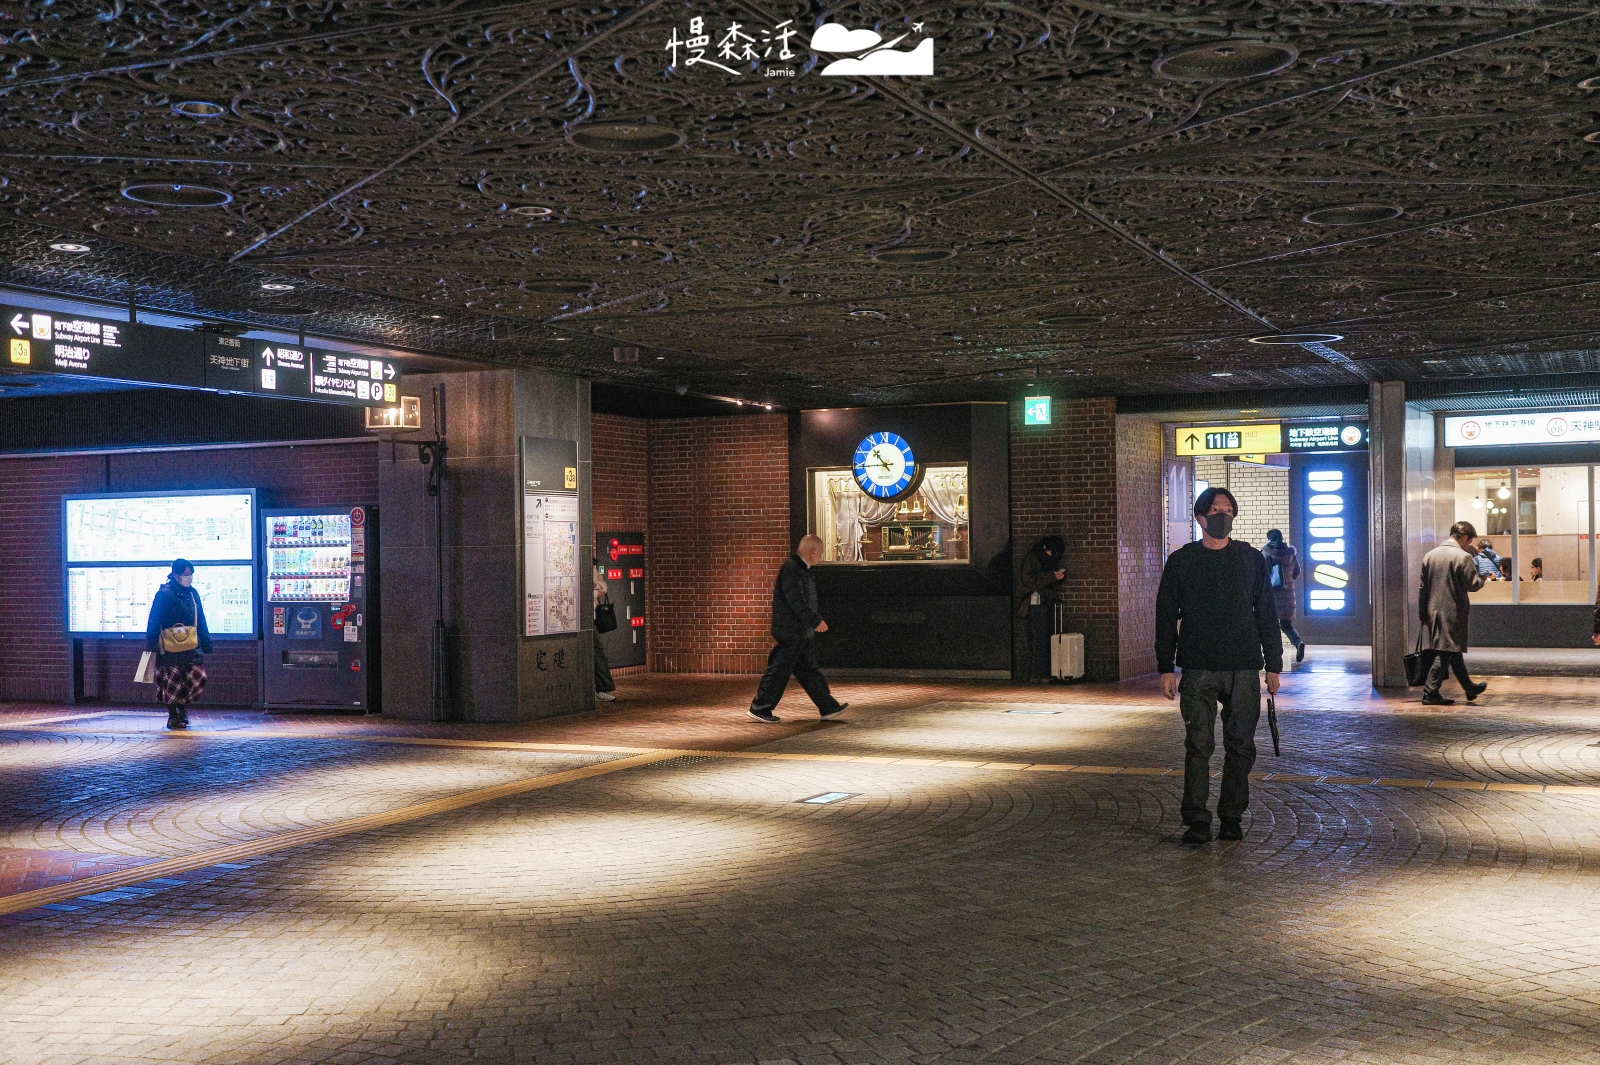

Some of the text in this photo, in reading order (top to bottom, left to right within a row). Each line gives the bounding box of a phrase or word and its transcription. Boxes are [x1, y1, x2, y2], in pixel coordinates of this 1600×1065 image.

[55, 331, 73, 342] Subway
[74, 333, 90, 343] Airport
[91, 335, 101, 344] Line
[55, 344, 90, 360] 明治通り
[69, 360, 88, 369] Avenue
[210, 355, 249, 368] 天神地下街
[1485, 419, 1536, 428] 地下鉄空港線
[1207, 434, 1221, 449] 11
[1170, 465, 1186, 519] 11
[1308, 470, 1349, 611] DOUTOR
